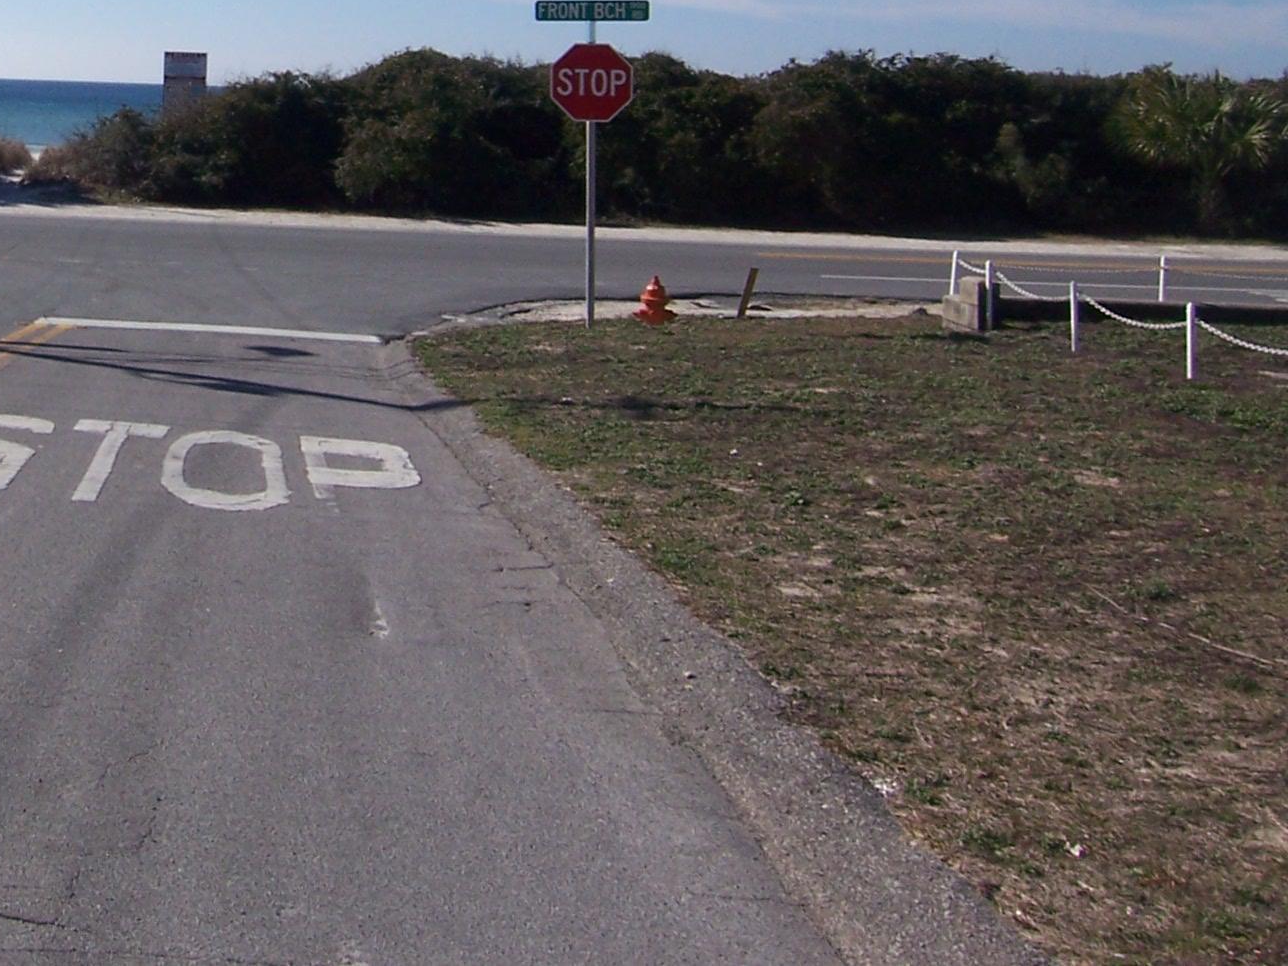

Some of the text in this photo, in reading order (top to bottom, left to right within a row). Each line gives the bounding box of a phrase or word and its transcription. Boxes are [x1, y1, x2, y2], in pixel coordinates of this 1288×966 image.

[537, 2, 587, 19] FRONT
[594, 2, 626, 19] BCH
[557, 68, 627, 96] STOP
